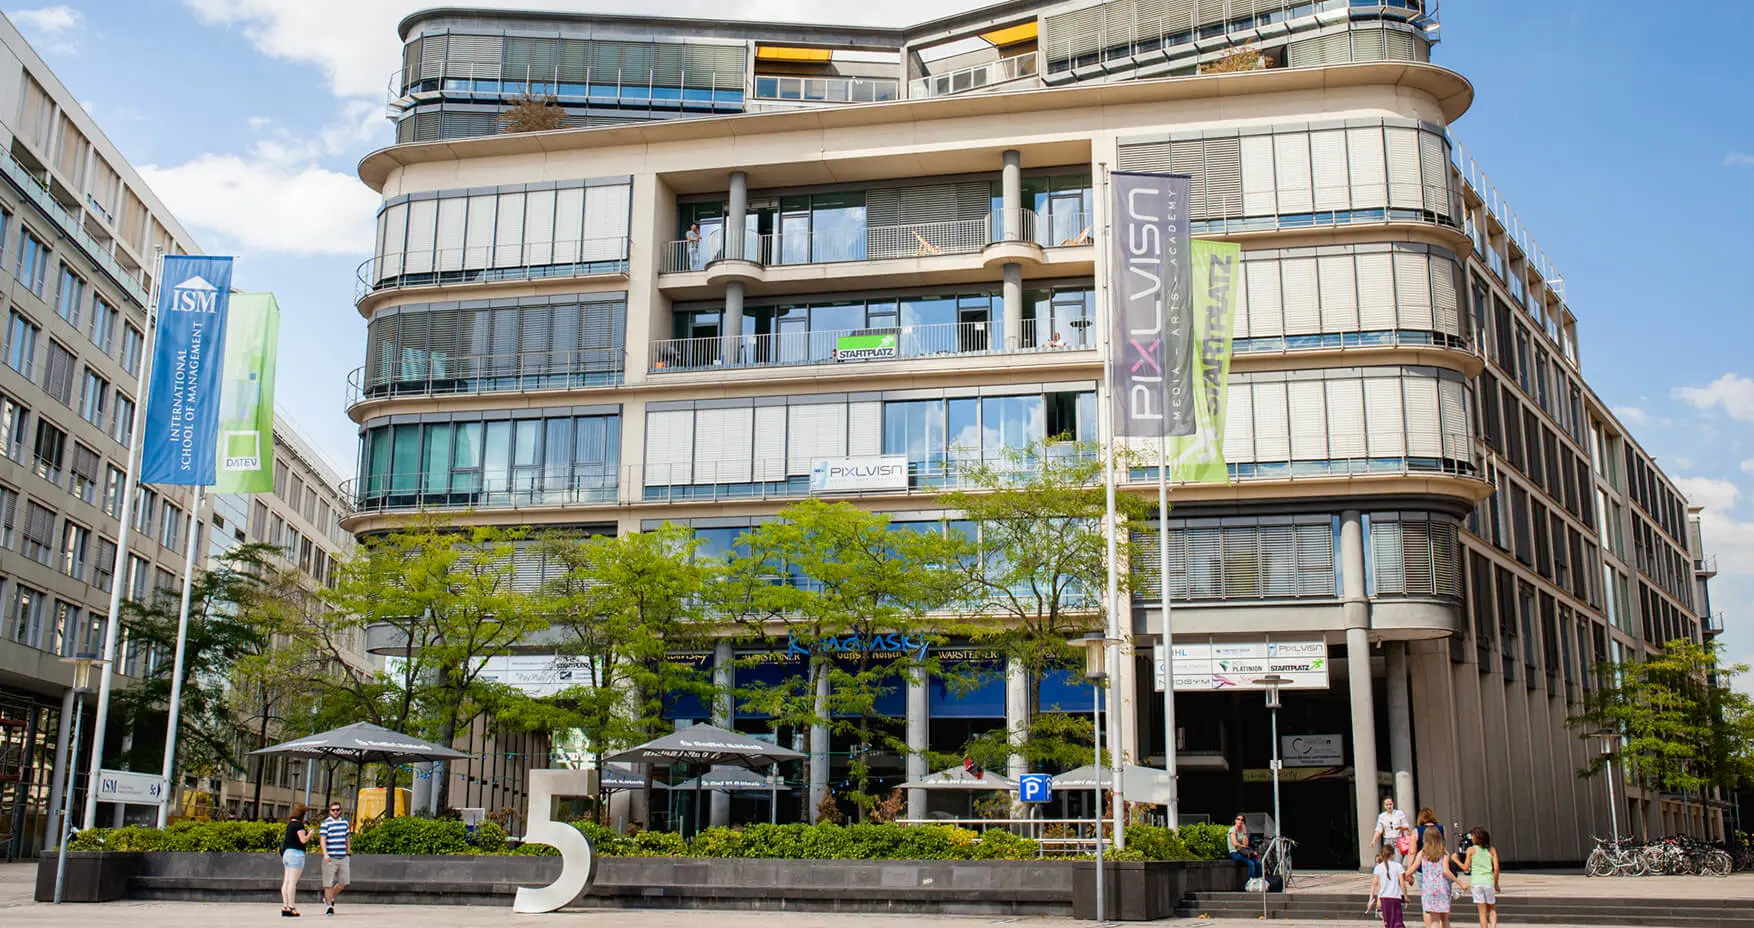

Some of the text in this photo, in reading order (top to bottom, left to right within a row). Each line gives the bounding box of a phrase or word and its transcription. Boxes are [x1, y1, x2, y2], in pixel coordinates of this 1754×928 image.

[171, 290, 218, 314] ISM
[1168, 190, 1182, 420] MEDIA ARTS ACADEMY
[1202, 254, 1232, 416] STARTPLATZ
[839, 348, 894, 359] STARTPLATZ
[169, 349, 188, 442] INTERNATIONAL
[180, 320, 204, 471] SCHOOL OF MANAGEMENT
[226, 458, 258, 467] DATEV
[1270, 664, 1310, 672] STARTPLATZ
[102, 779, 118, 793] ISM
[1026, 782, 1040, 799] P
[513, 769, 594, 913] 5
